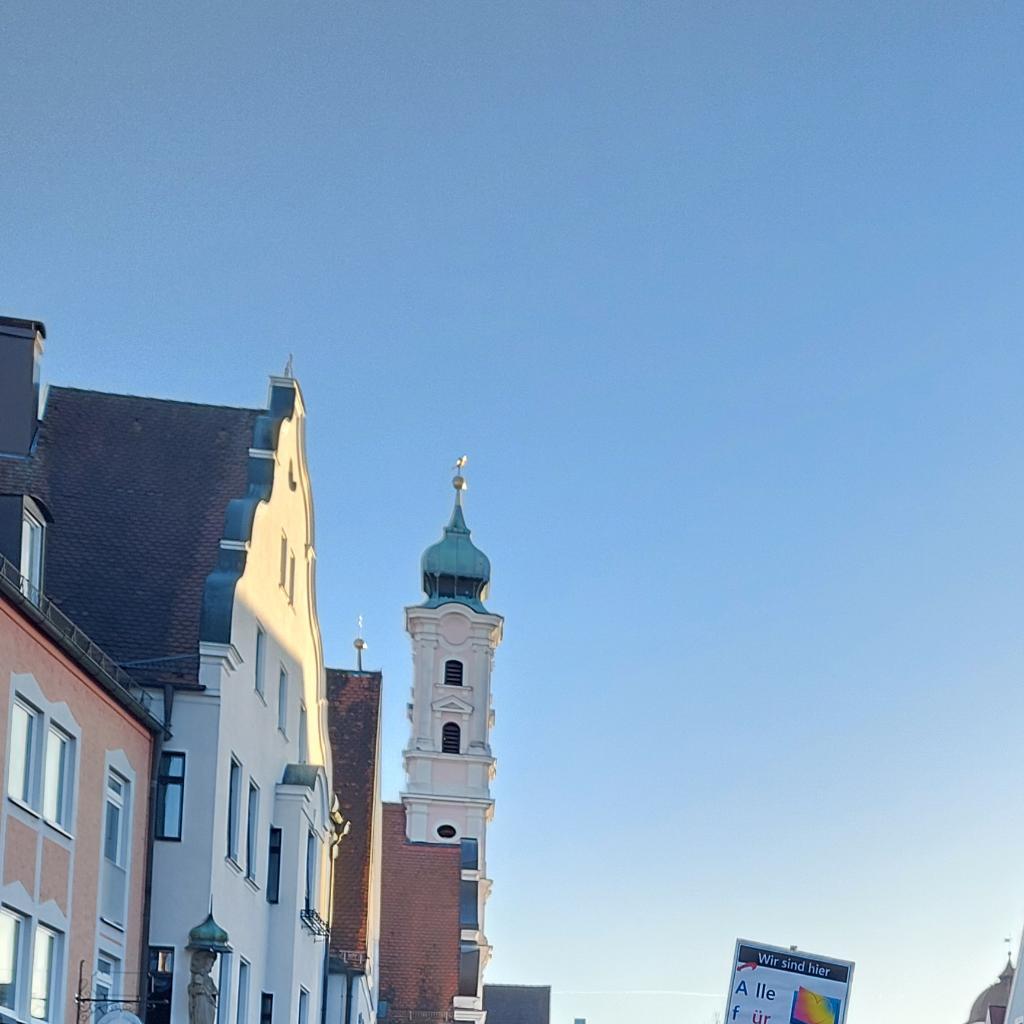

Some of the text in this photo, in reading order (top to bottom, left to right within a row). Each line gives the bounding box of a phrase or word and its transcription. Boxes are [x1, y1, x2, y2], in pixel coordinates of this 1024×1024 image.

[758, 952, 831, 978] Wir sind hier
